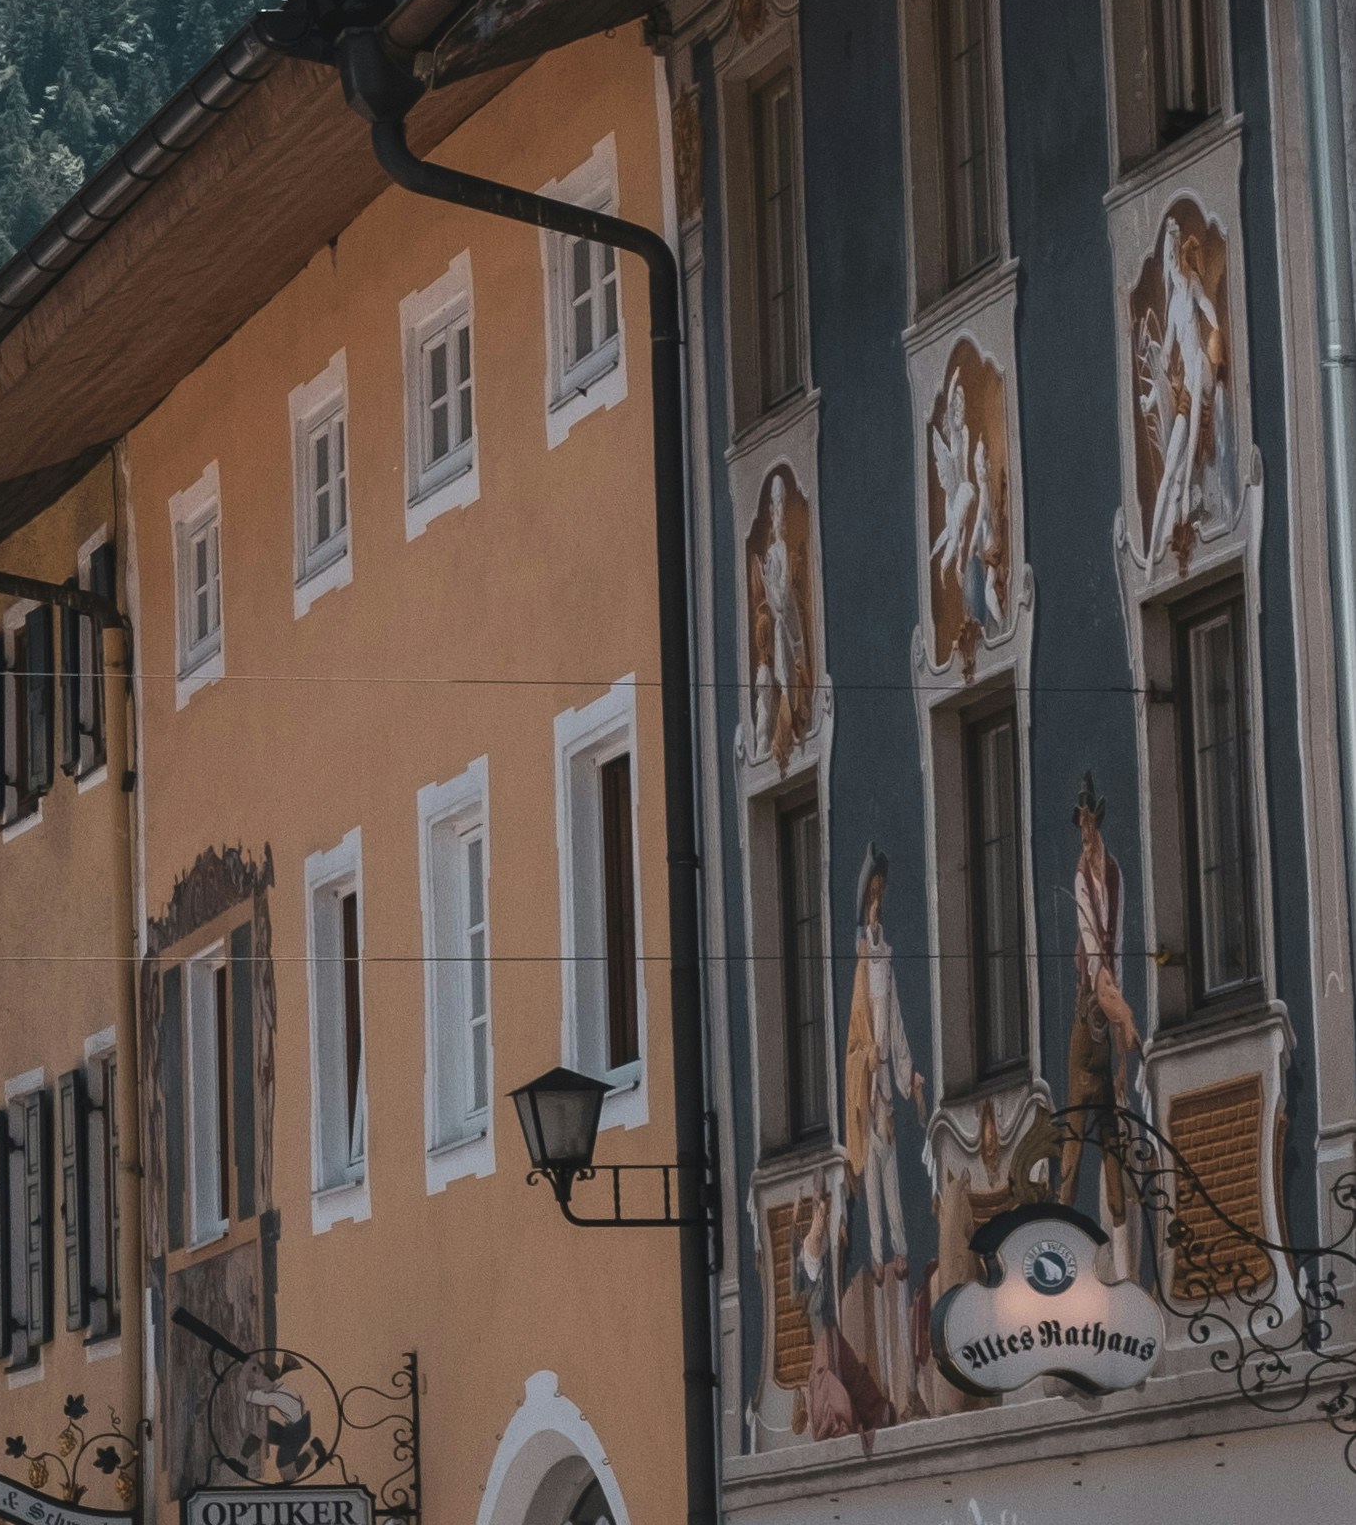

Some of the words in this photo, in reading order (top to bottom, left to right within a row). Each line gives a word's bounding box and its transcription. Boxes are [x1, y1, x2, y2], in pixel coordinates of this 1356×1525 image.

[961, 1325, 1035, 1371] Altes
[1037, 1319, 1156, 1362] Rathaus
[2, 1491, 19, 1510] &
